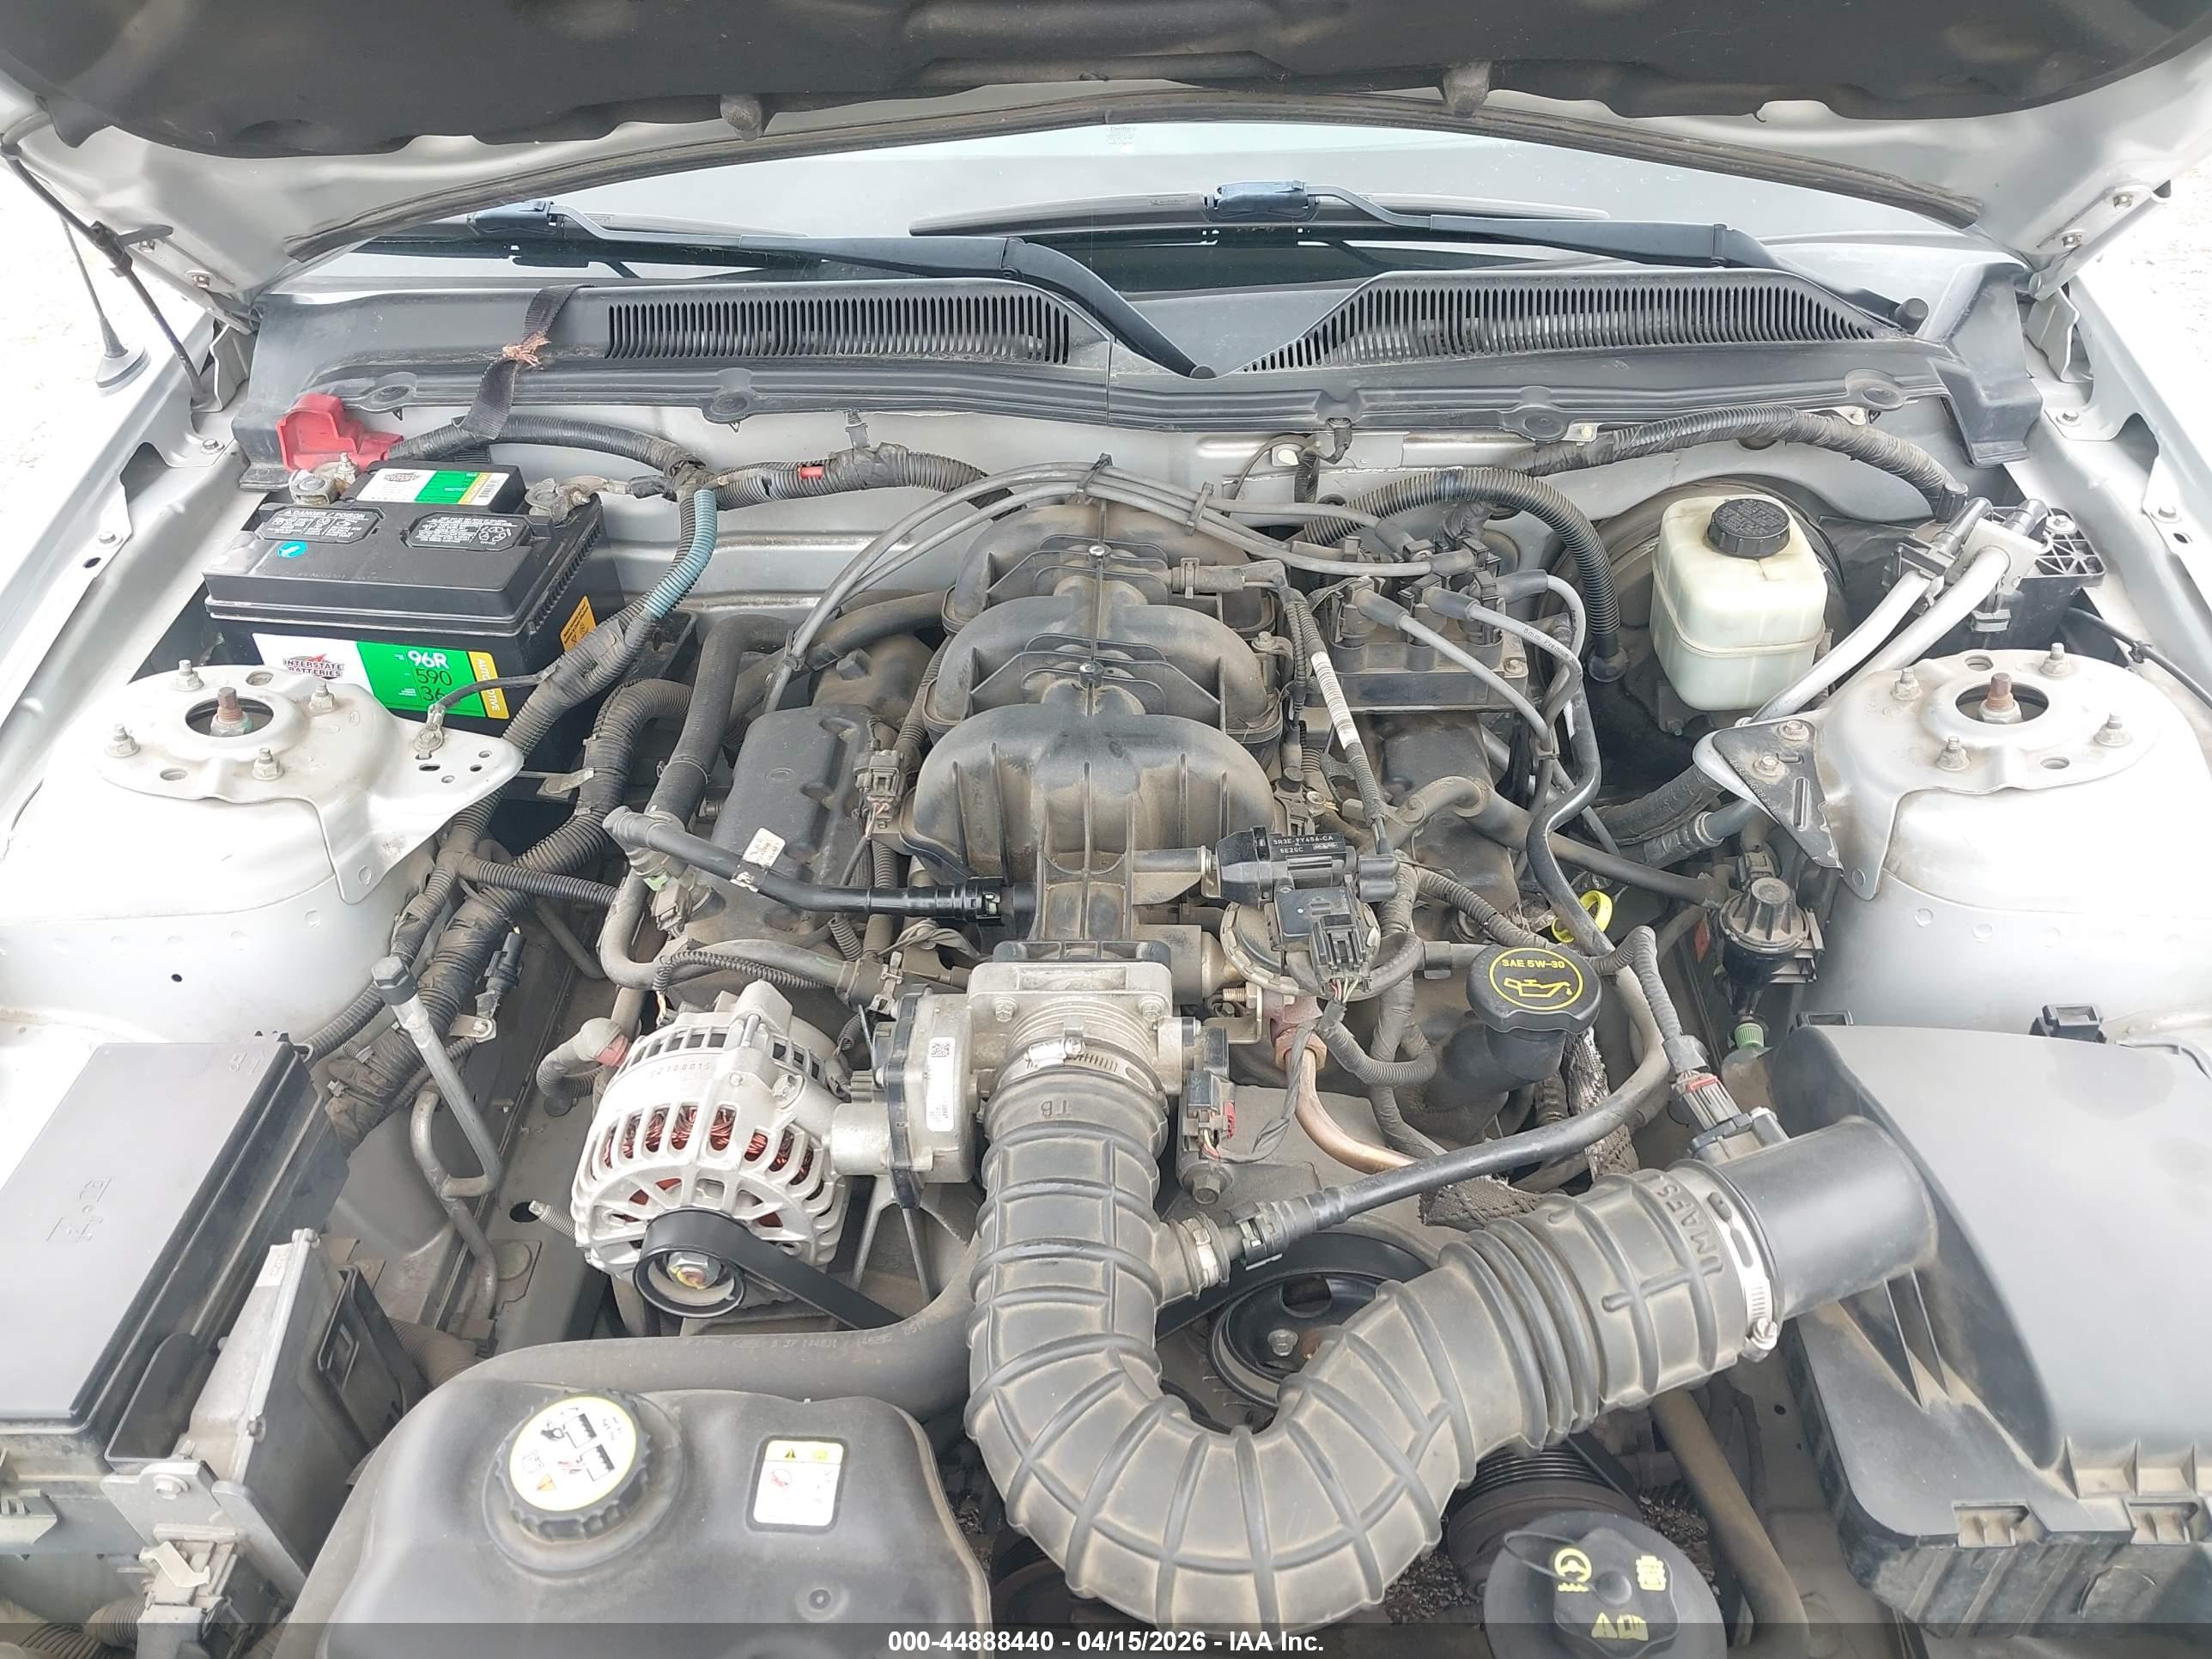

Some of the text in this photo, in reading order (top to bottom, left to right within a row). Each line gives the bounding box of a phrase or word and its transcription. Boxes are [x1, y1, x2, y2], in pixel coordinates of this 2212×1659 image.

[283, 659, 343, 672] INTERSTATE
[407, 650, 450, 670] 96R
[416, 668, 453, 686] 590
[1502, 958, 1565, 969] SAE 5W-30
[1040, 1099, 1072, 1117] TB
[1656, 1184, 1718, 1255] MAFS
